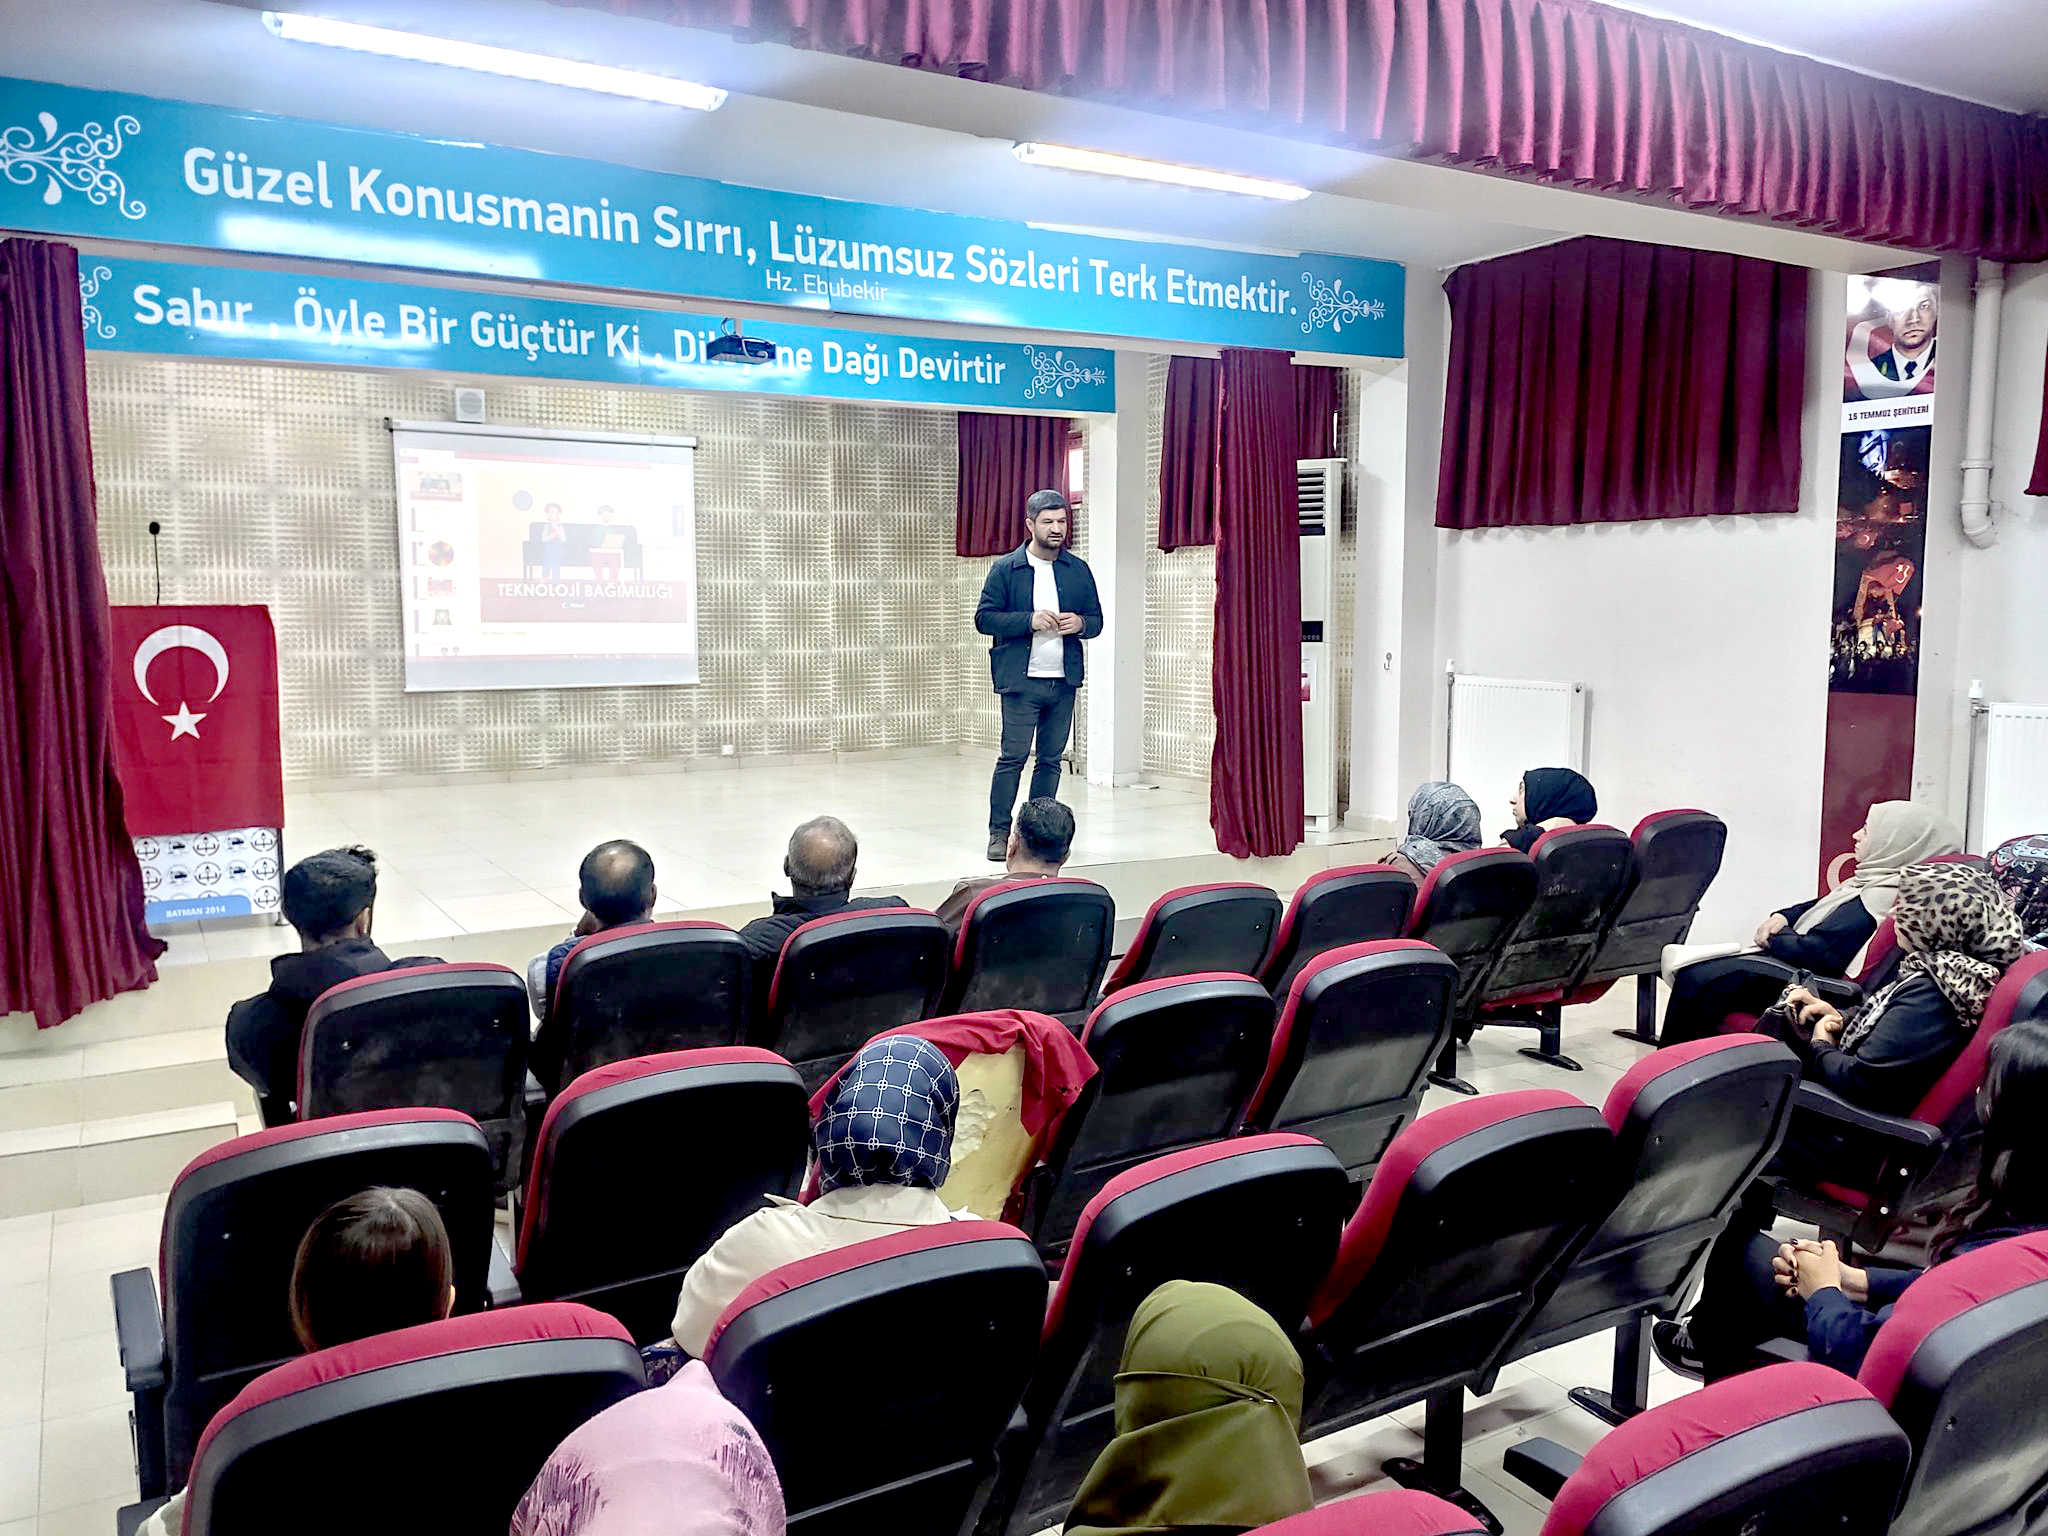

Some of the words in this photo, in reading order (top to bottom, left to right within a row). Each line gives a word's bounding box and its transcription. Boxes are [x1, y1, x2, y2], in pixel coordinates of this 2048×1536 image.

[183, 147, 333, 209] Güzel
[348, 165, 640, 244] Konusmanin
[653, 205, 757, 266] Sırrı,
[769, 220, 955, 280] Lüzumsuz
[965, 244, 1079, 293] Sözleri
[1088, 257, 1158, 301] Terk
[1166, 267, 1297, 315] Etmektir.
[766, 269, 798, 292] Hz.
[803, 273, 888, 301] Ebubekir
[294, 286, 386, 345] Öyle
[400, 303, 458, 344] Bir
[470, 311, 595, 361] Güçtür
[606, 322, 640, 367] Ki
[823, 341, 889, 385] Dağı
[899, 347, 1006, 384] Devirtir
[1848, 412, 1858, 421] 15
[1860, 409, 1891, 419] TEMMUZ
[1893, 404, 1929, 418] ŞEHİTLERİ
[497, 581, 580, 598] TEKNOLOJİ
[584, 582, 673, 599] BAĞIMLILIĞI
[166, 907, 203, 918] BATMAN
[205, 905, 226, 915] 2014
